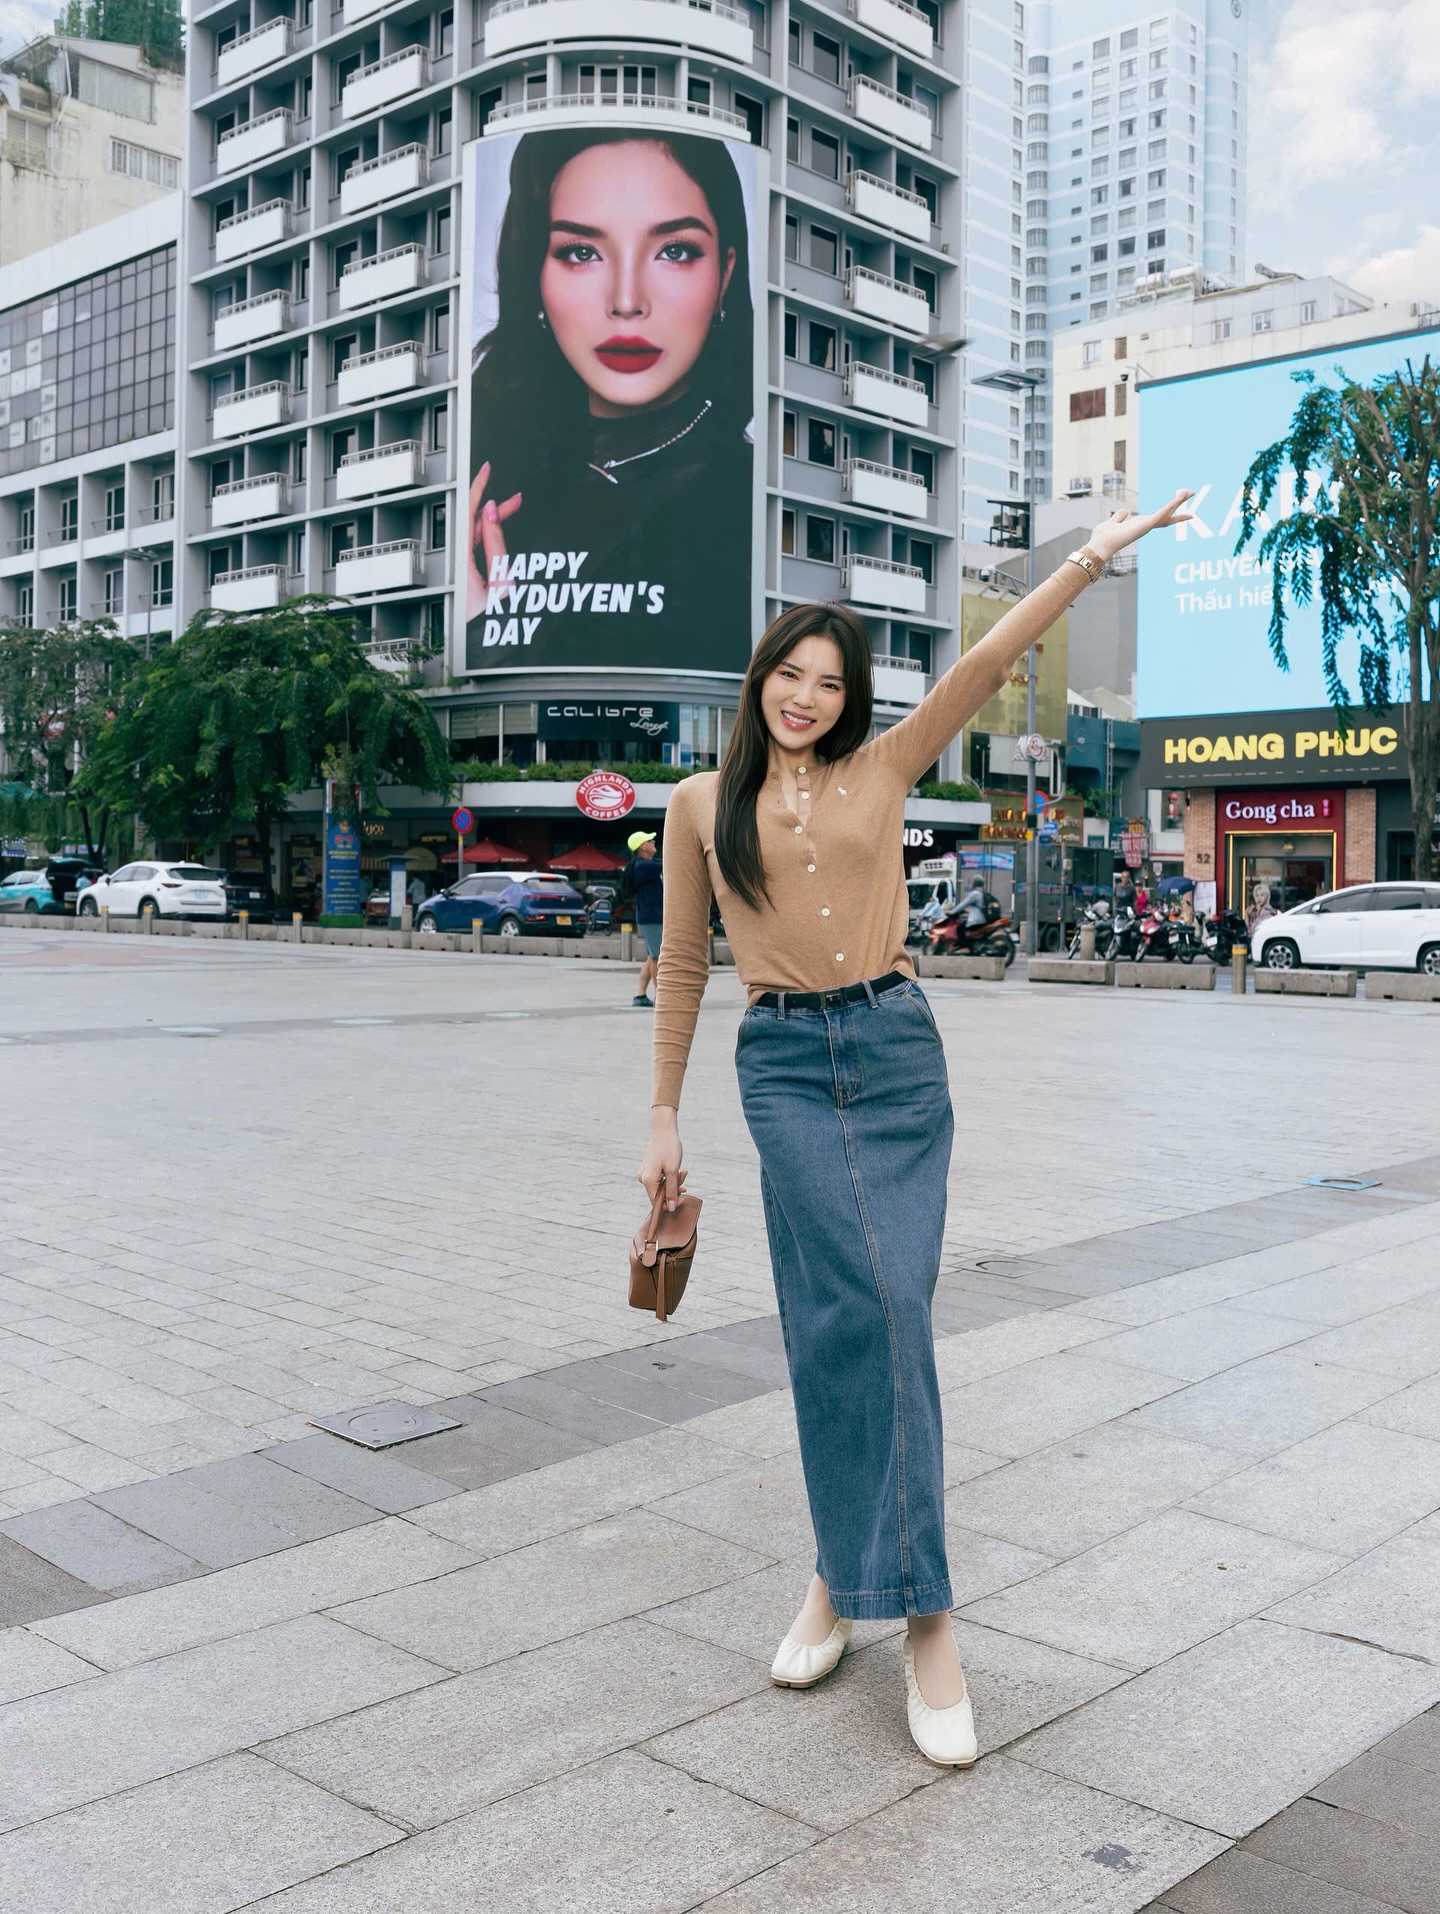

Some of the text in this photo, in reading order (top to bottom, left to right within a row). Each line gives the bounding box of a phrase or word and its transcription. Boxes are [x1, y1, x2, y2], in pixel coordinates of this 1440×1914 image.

[488, 551, 589, 582] HAPPY
[485, 581, 665, 615] KYDUYEN'S
[1174, 587, 1232, 614] Thấu
[482, 617, 542, 647] DAY
[1164, 726, 1398, 764] HOANG PHUC
[579, 774, 633, 794] HIGHLANDS
[585, 806, 626, 818] COFFEE
[1225, 800, 1277, 824] Gong
[1280, 799, 1316, 818] cha
[1196, 852, 1211, 865] 52
